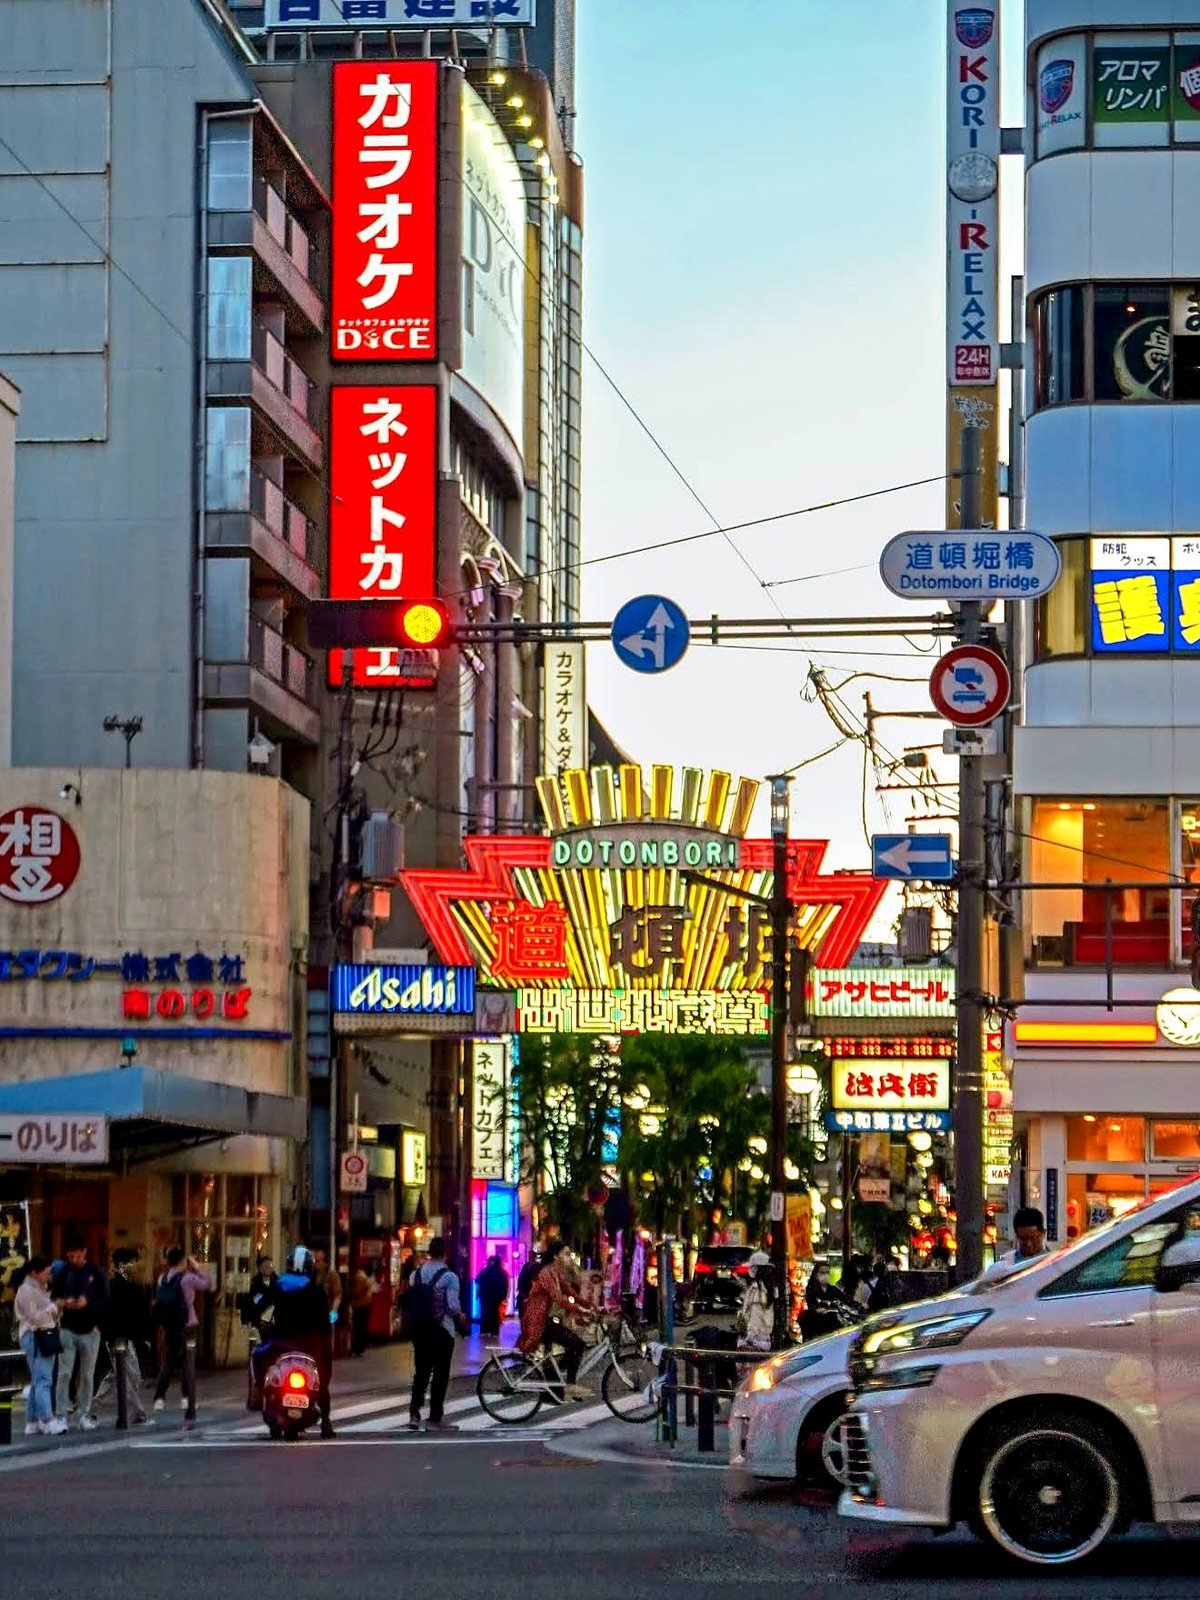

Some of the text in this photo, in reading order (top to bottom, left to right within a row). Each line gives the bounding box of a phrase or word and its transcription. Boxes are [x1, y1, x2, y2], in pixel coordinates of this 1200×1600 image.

[1099, 60, 1160, 81] アロマ
[1105, 85, 1167, 110] リンパ
[356, 73, 413, 310] カラオケ
[957, 348, 989, 365] 24H
[359, 398, 408, 676] ネットカェ
[906, 541, 1034, 570] 道頓堀橋
[900, 574, 1040, 591] Dotombori Bridge
[554, 839, 737, 865] DOTONBORI
[349, 967, 456, 1009] Asahi
[821, 980, 949, 1003] アサヒビール
[476, 1052, 494, 1160] ネットカフェ
